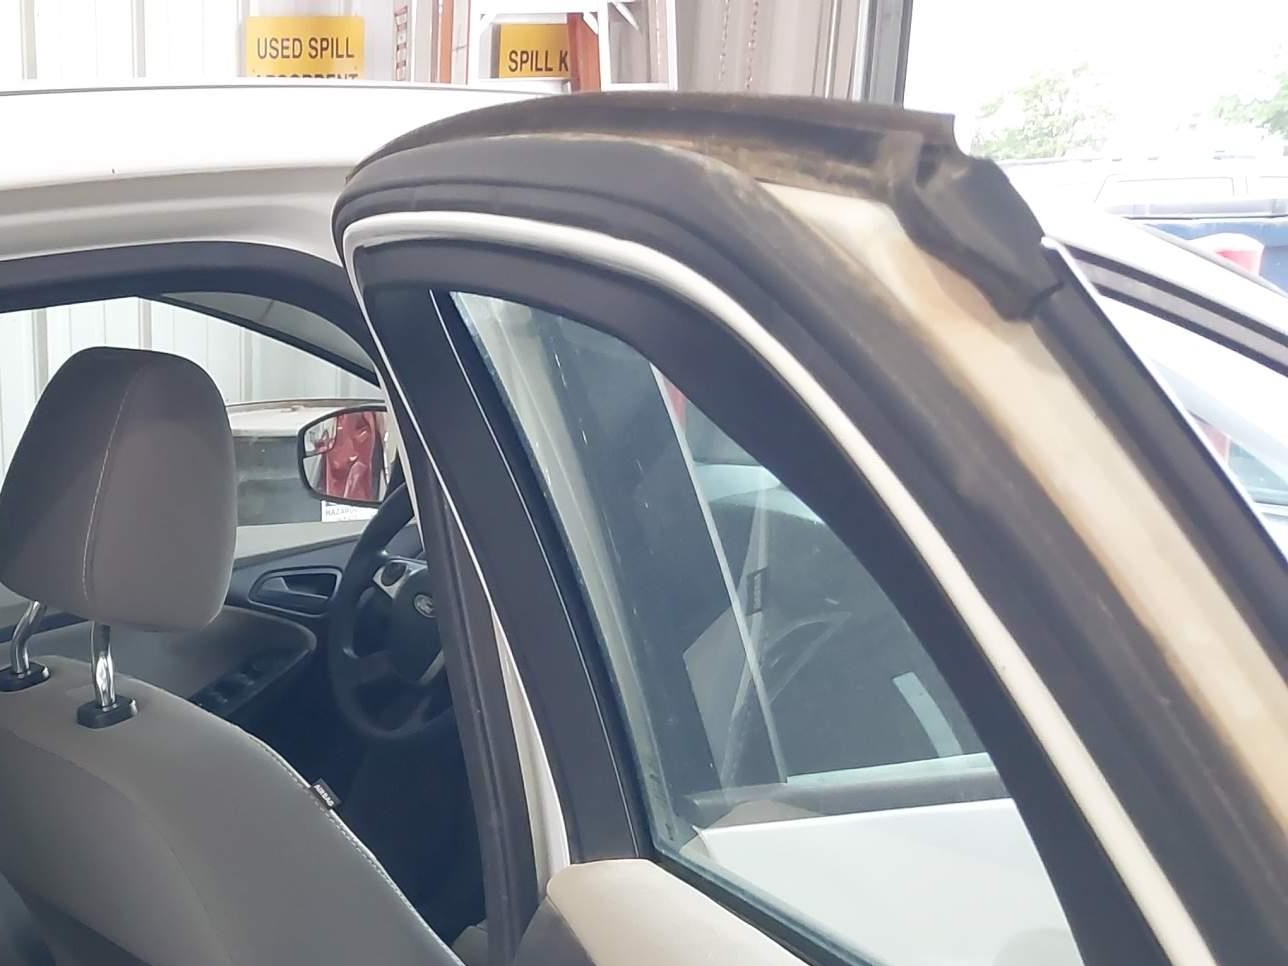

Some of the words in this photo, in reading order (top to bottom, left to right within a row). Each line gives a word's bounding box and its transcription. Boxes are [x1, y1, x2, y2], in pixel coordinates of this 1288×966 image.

[257, 37, 303, 59] USED
[308, 37, 355, 59] SPILL
[508, 49, 554, 72] SPILL
